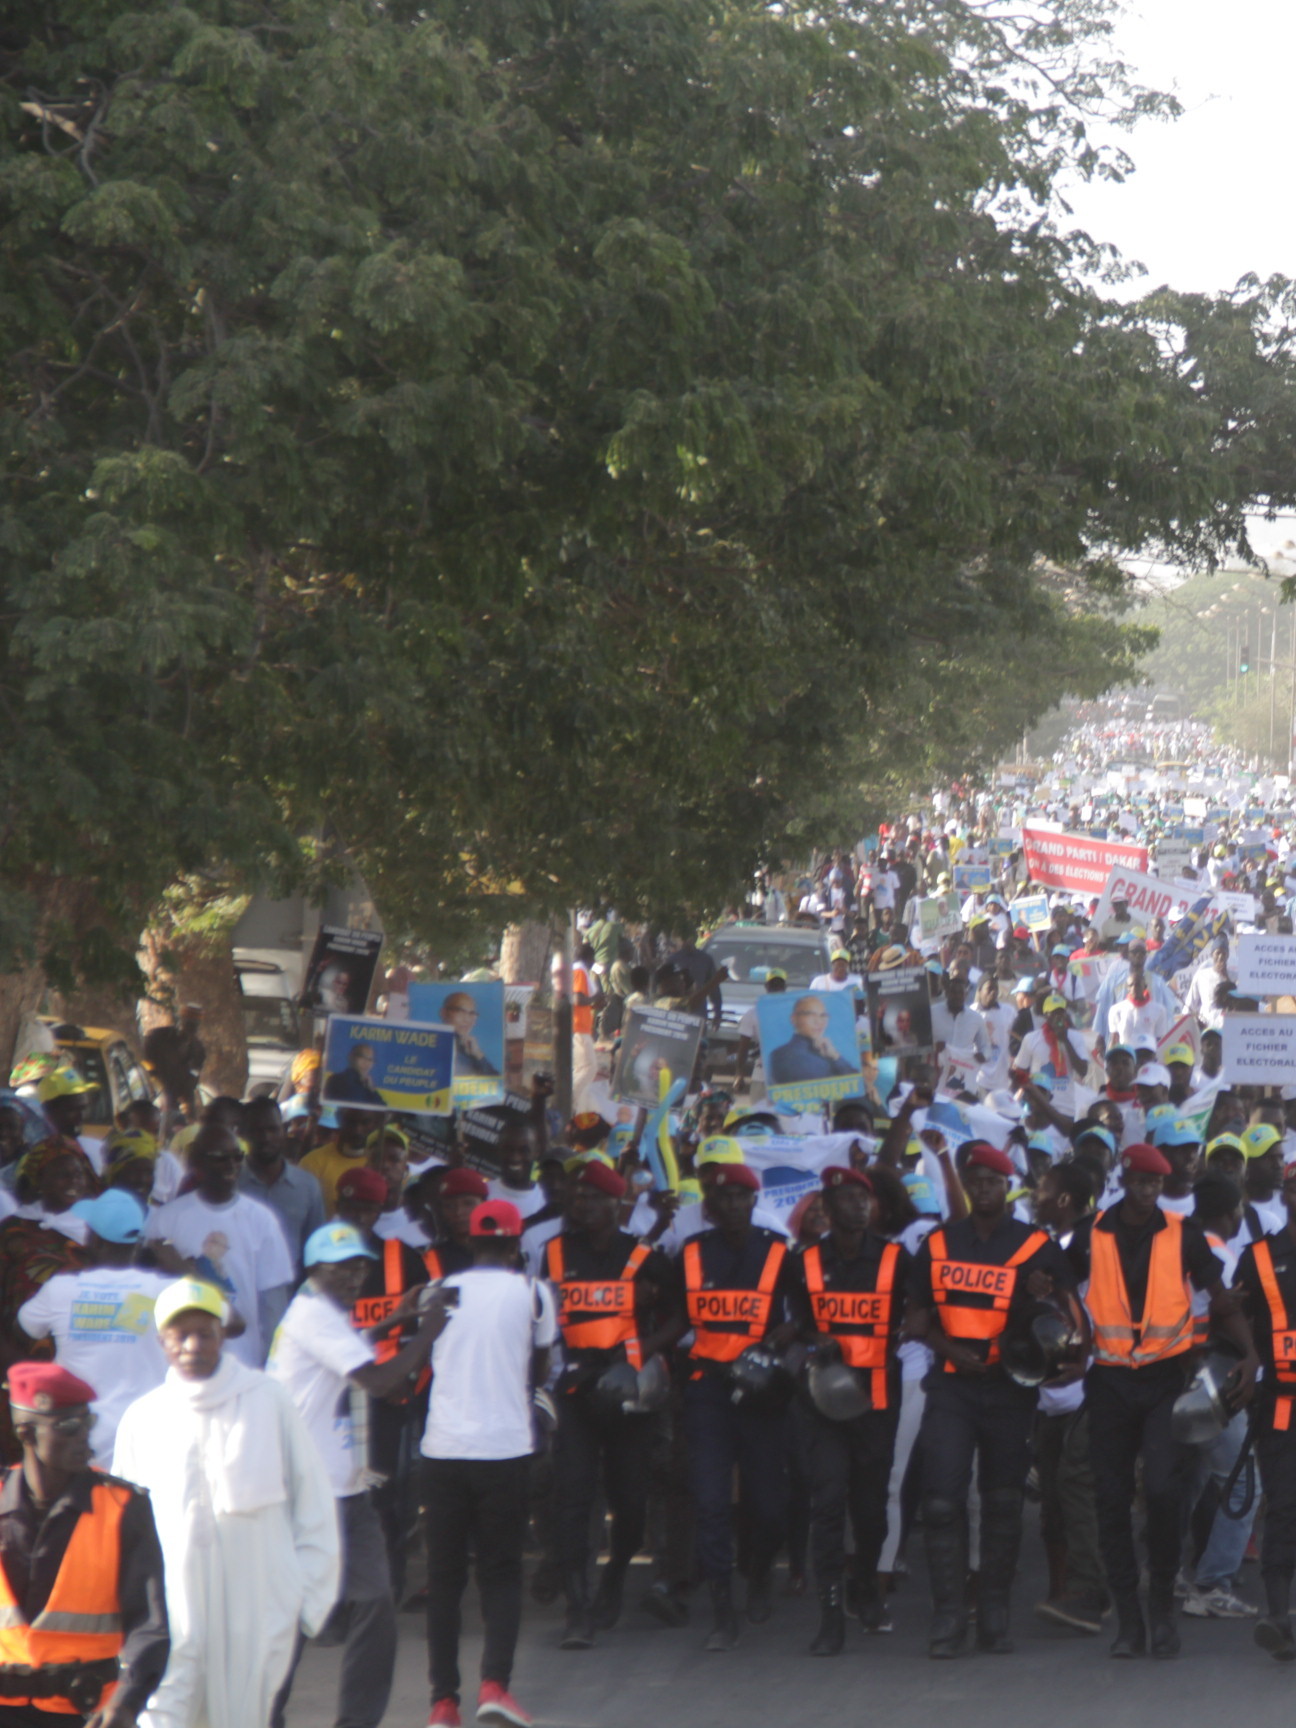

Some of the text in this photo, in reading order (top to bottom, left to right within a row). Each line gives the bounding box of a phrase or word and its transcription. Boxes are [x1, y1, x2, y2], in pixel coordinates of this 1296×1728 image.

[1066, 846, 1097, 863] PARTI
[1105, 851, 1141, 869] DAKAR
[1254, 944, 1283, 953] ACCES
[1258, 958, 1296, 967] FICHIER
[350, 1025, 438, 1048] KARIM WADE
[1241, 1027, 1293, 1037] ACCES AU
[1246, 1043, 1288, 1052] FICHIER
[404, 1055, 418, 1064] LE
[1236, 1057, 1296, 1068] ELECTORAL
[386, 1064, 436, 1077] CANDIDAT
[384, 1075, 438, 1089] DU PEUPLE
[940, 1265, 1008, 1291] POLICE
[561, 1287, 625, 1309] POLICE
[353, 1300, 394, 1323] LICE
[697, 1295, 761, 1318] POLICE
[817, 1297, 881, 1320] POLICE
